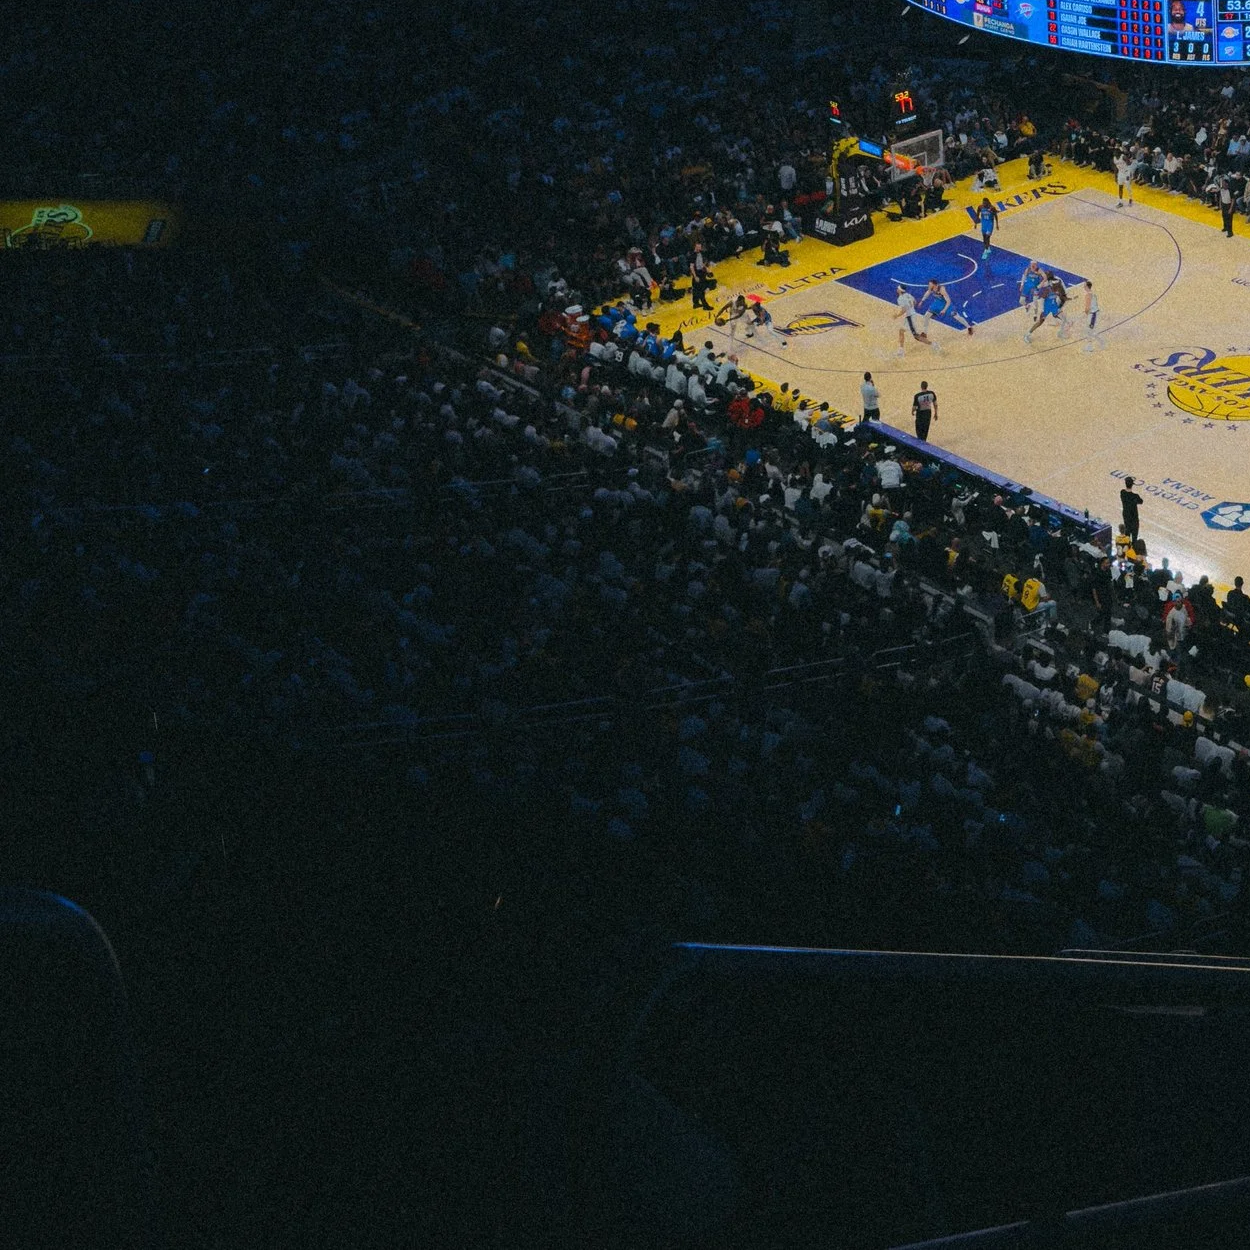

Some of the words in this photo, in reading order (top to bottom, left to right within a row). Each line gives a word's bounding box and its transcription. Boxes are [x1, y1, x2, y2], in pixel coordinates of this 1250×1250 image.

[1196, 1, 1205, 17] 4
[966, 181, 1075, 224] LKERS
[766, 266, 847, 296] ULTRA
[1162, 477, 1216, 502] ARENA
